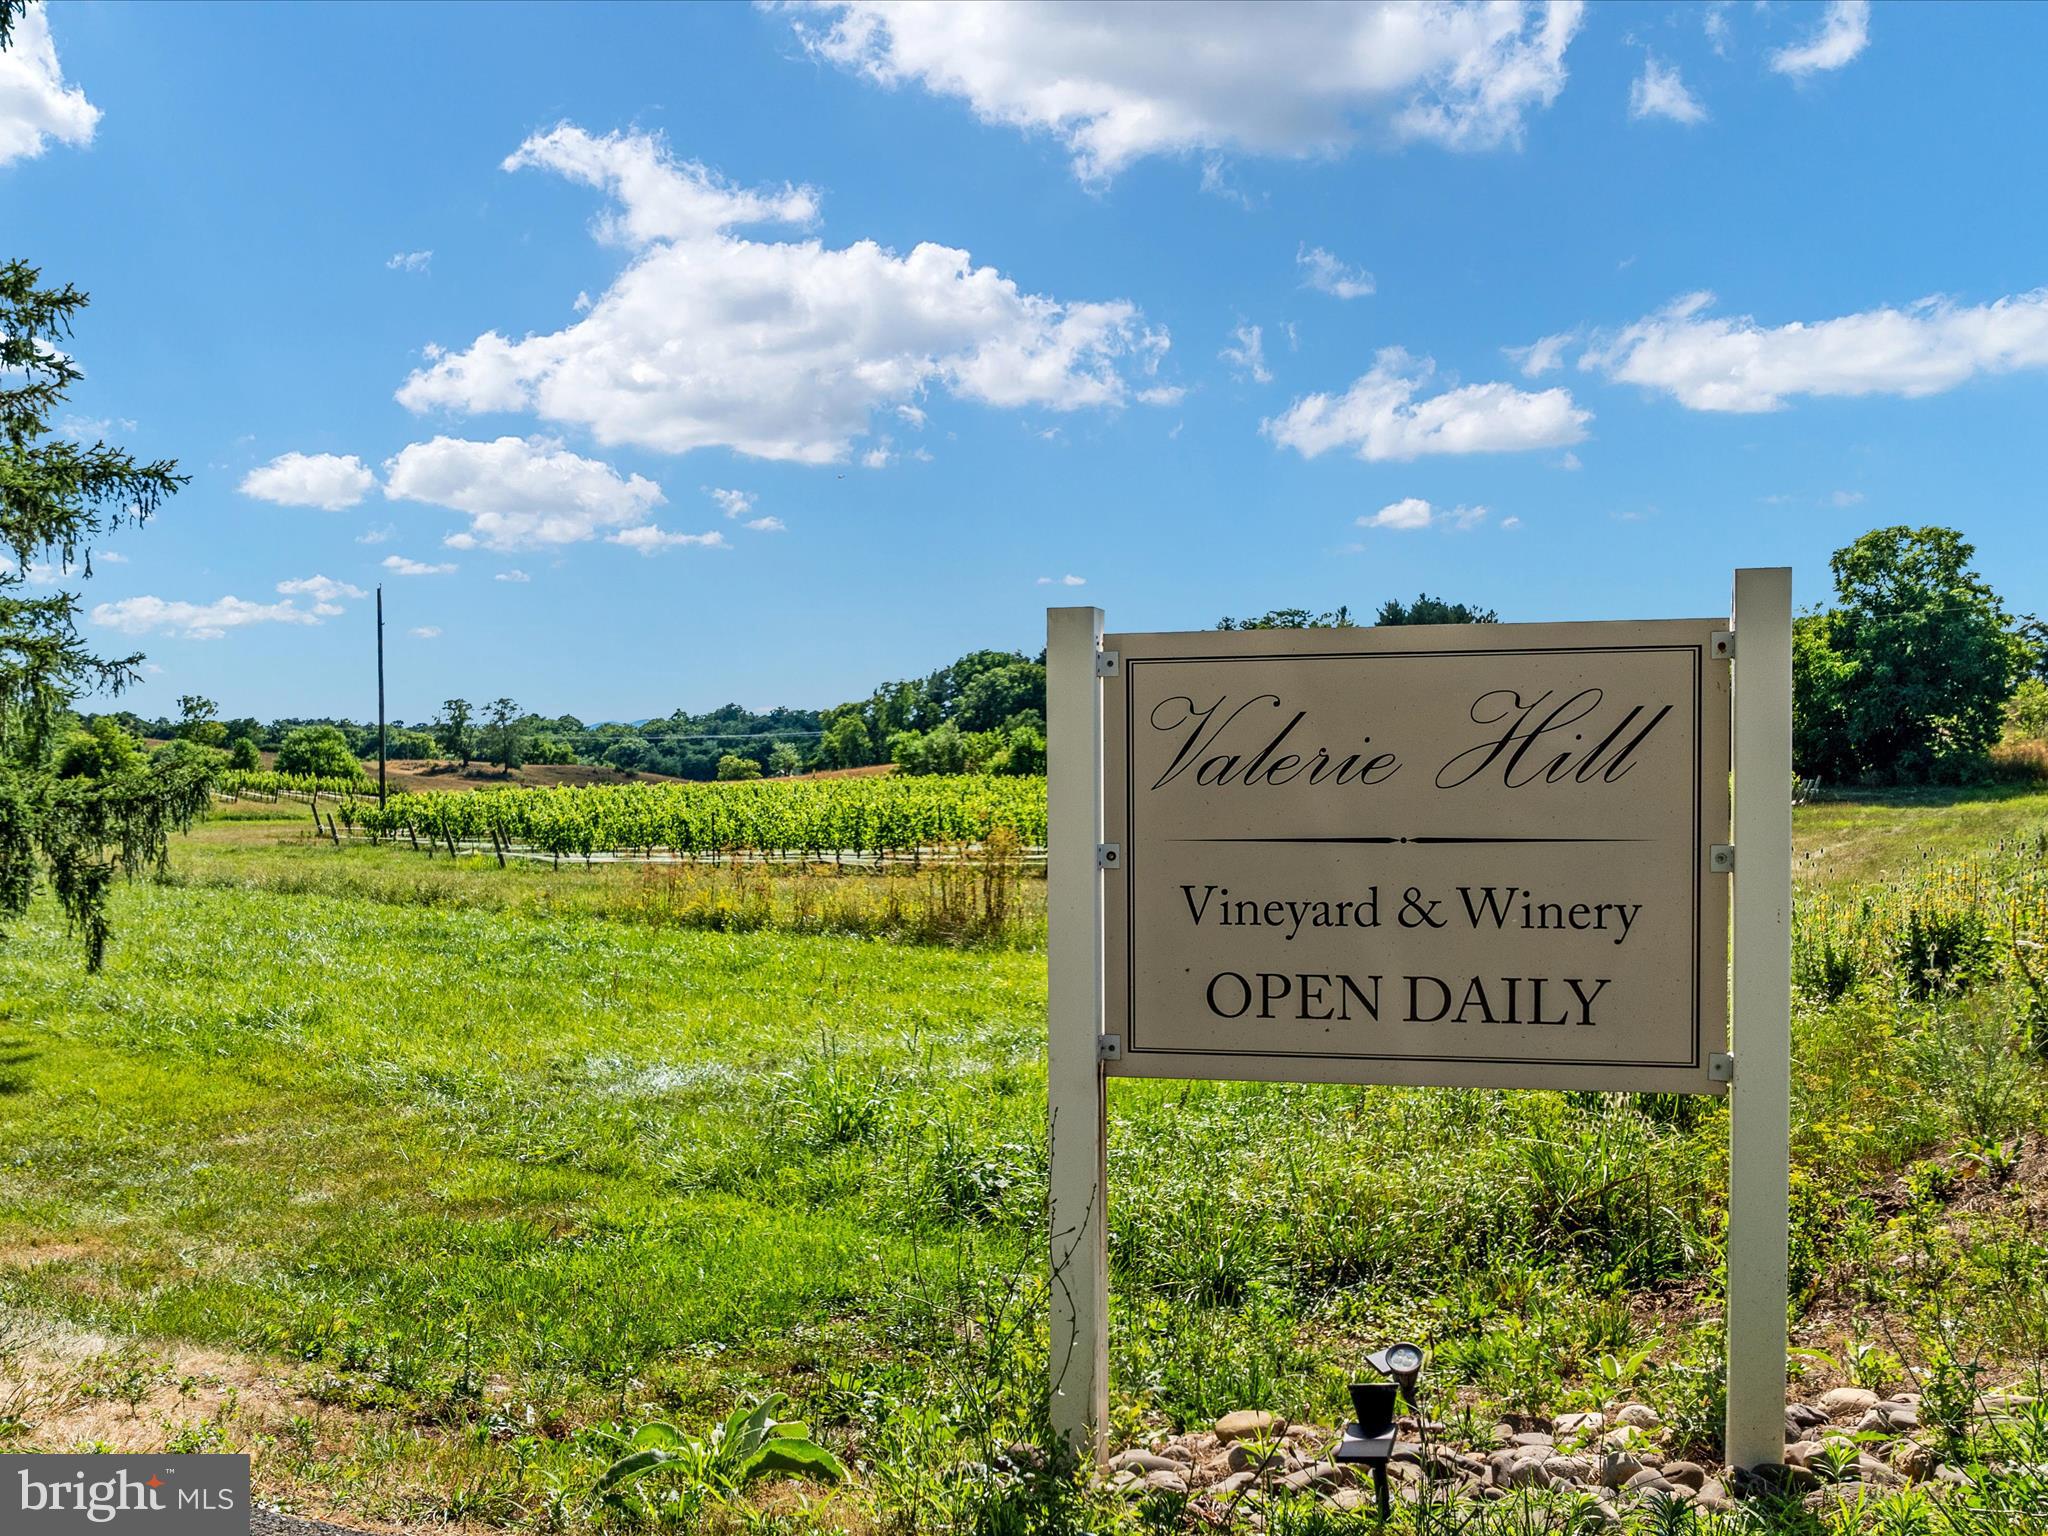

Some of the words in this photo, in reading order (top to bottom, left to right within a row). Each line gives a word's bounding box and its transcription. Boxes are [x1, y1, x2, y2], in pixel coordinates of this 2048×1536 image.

[1151, 693, 1403, 791] Valerie
[1435, 688, 1674, 790] Hill
[1180, 885, 1382, 941] Vineyard
[1398, 887, 1449, 929] &
[1456, 887, 1643, 946] Winery
[1206, 971, 1384, 1021] OPEN
[1402, 976, 1612, 1027] DAILY
